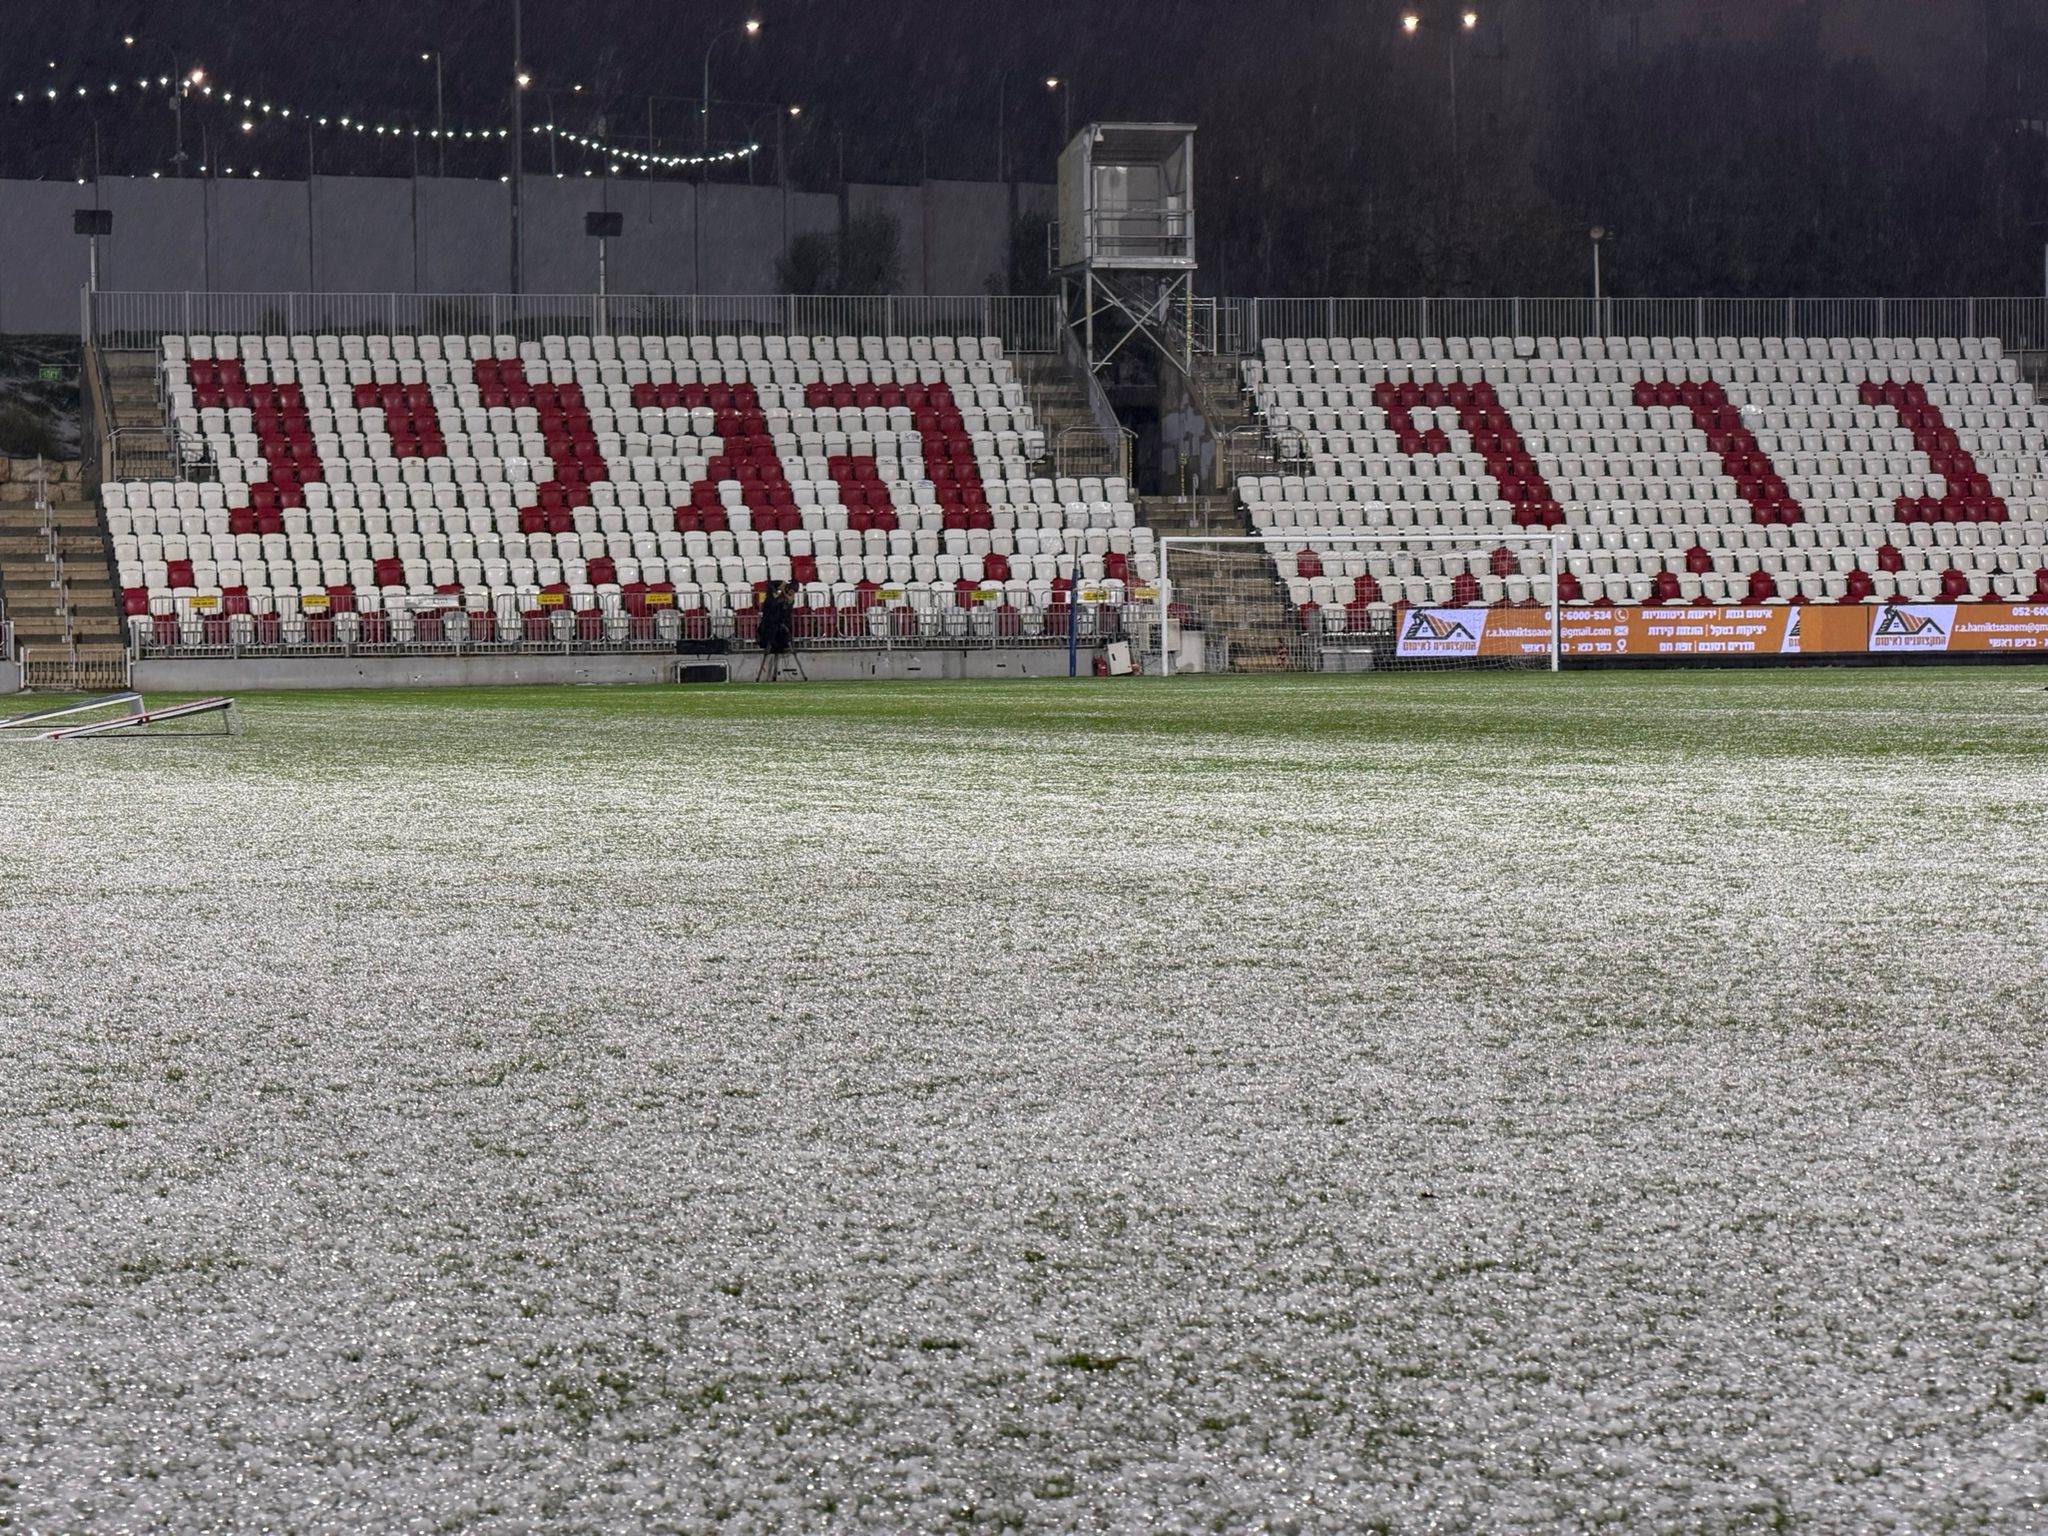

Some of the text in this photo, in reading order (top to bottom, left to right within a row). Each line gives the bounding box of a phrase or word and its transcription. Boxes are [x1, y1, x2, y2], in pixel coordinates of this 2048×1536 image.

[1641, 609, 1773, 620] איטום גגות יריעות ביטומניות
[1648, 626, 1674, 637] קירות
[1736, 625, 1767, 637] יציקות
[1727, 641, 1755, 651] חדרים
[1988, 638, 2012, 648] ראשי
